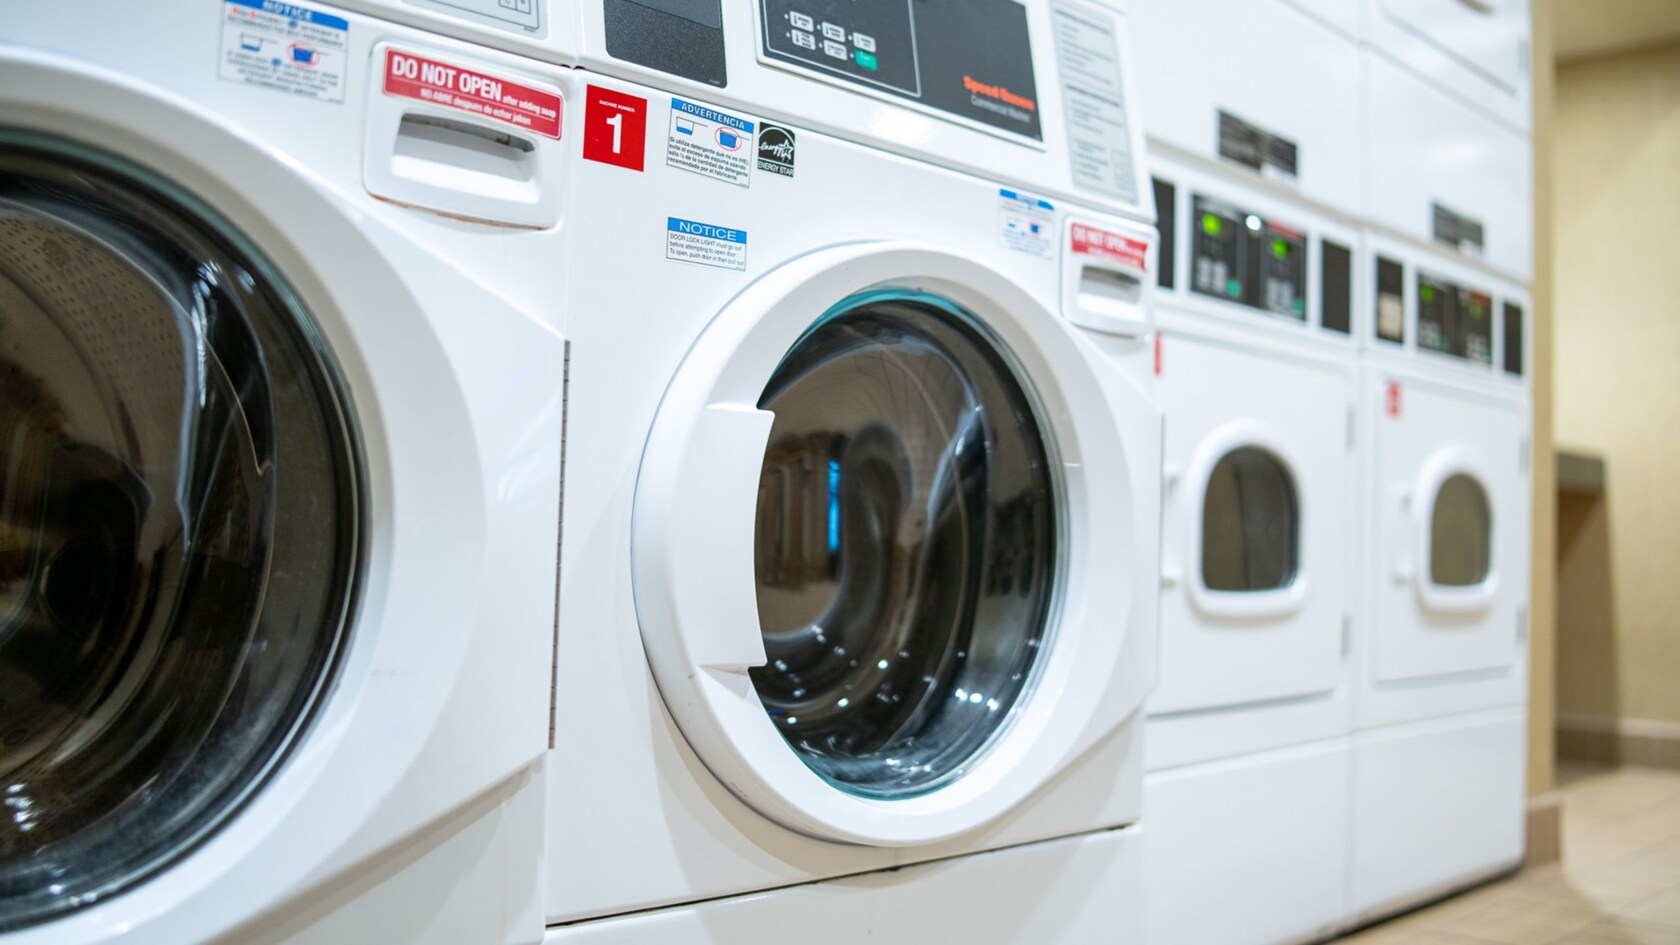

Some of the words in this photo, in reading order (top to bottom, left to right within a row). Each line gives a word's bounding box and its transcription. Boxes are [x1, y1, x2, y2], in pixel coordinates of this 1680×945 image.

[392, 55, 418, 79] DO
[421, 63, 457, 89] NOT
[459, 72, 502, 102] OPEN
[502, 95, 518, 106] after
[519, 100, 540, 115] adding
[541, 107, 556, 119] soap
[420, 88, 433, 99] NO
[963, 75, 1000, 99] Speed
[1000, 87, 1036, 112] Queen
[599, 99, 617, 109] MACHINE
[681, 102, 745, 130] ADVERTENCIA
[606, 113, 622, 154] 1
[676, 139, 690, 148] utiliza
[691, 142, 715, 155] detergente
[716, 151, 725, 159] que
[668, 156, 700, 170] recomendada
[687, 149, 703, 158] exceso
[711, 156, 729, 166] espuma
[730, 161, 746, 170] usando
[697, 158, 717, 168] cantidad
[725, 166, 748, 178] detergente
[758, 160, 779, 173] ENERGY
[780, 166, 794, 176] STAR
[670, 233, 686, 241] DOOR
[686, 236, 700, 244] LOCK
[701, 238, 716, 246] LIGHT
[680, 221, 737, 241] NOTICE
[685, 244, 708, 254] attempting
